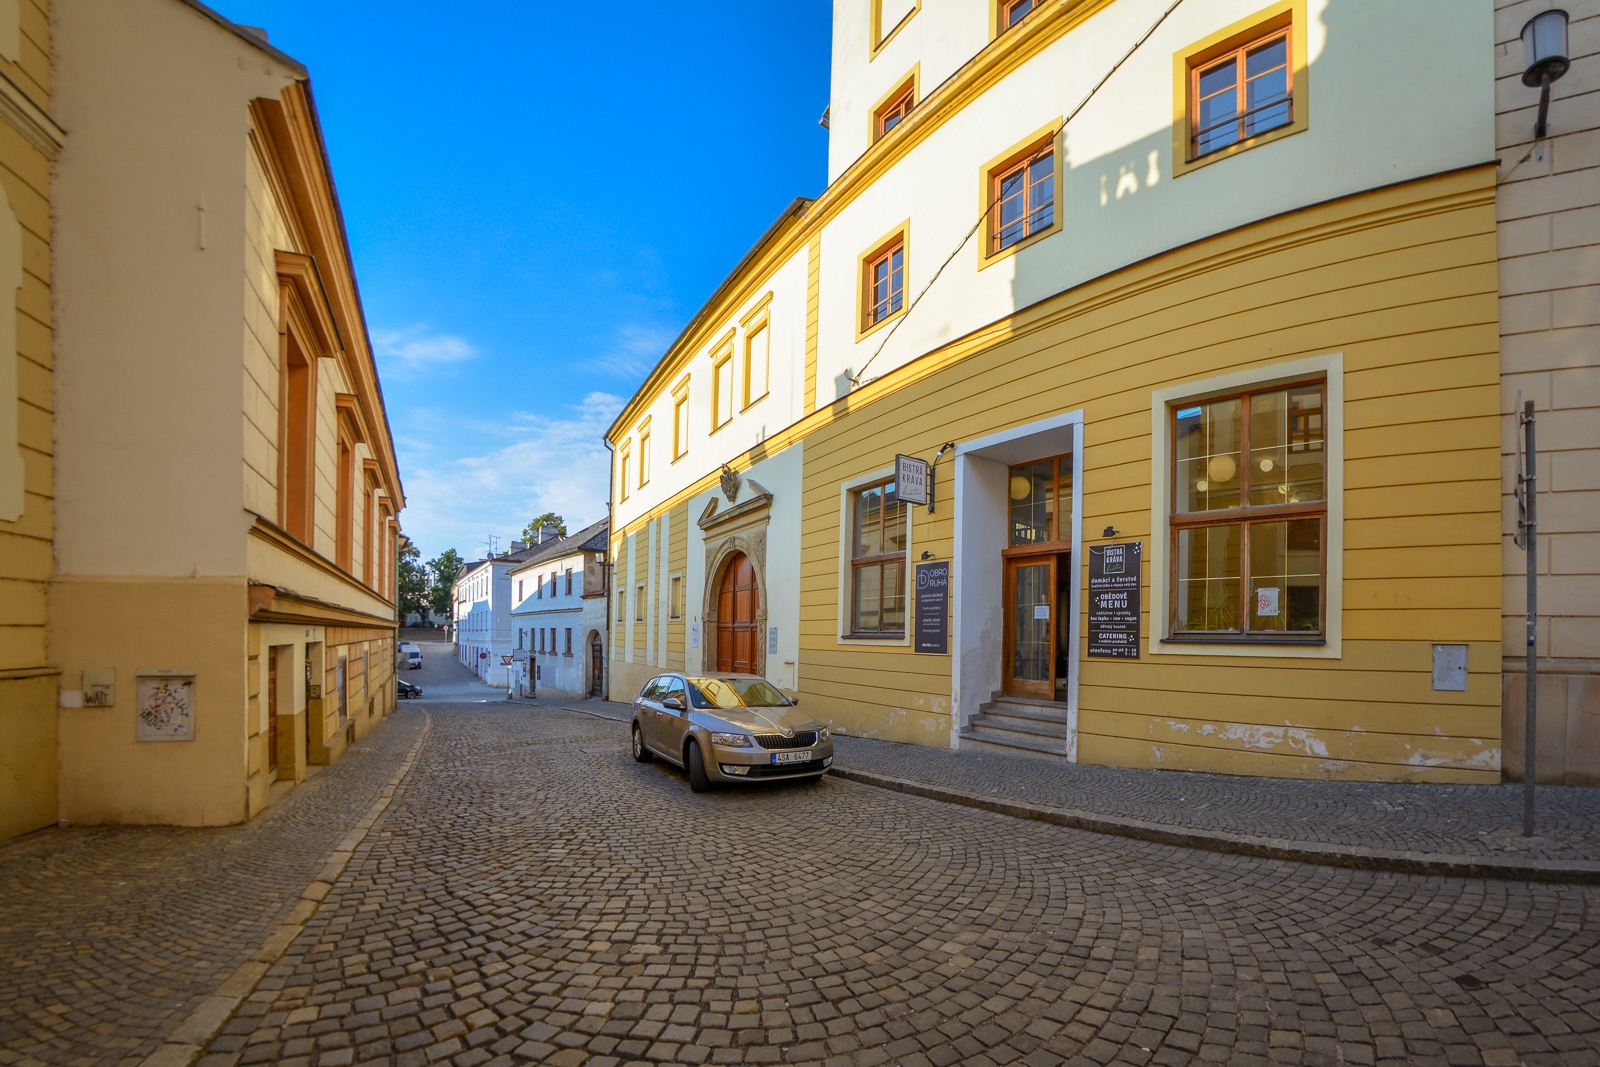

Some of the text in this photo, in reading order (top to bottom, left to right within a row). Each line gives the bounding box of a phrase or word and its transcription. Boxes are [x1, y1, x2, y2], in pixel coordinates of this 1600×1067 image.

[902, 462, 923, 476] BISTRÁ
[902, 473, 923, 487] KRÁVA
[1106, 548, 1123, 556] BISTRÁ
[1100, 600, 1127, 608] MENU
[794, 752, 809, 760] 6477
